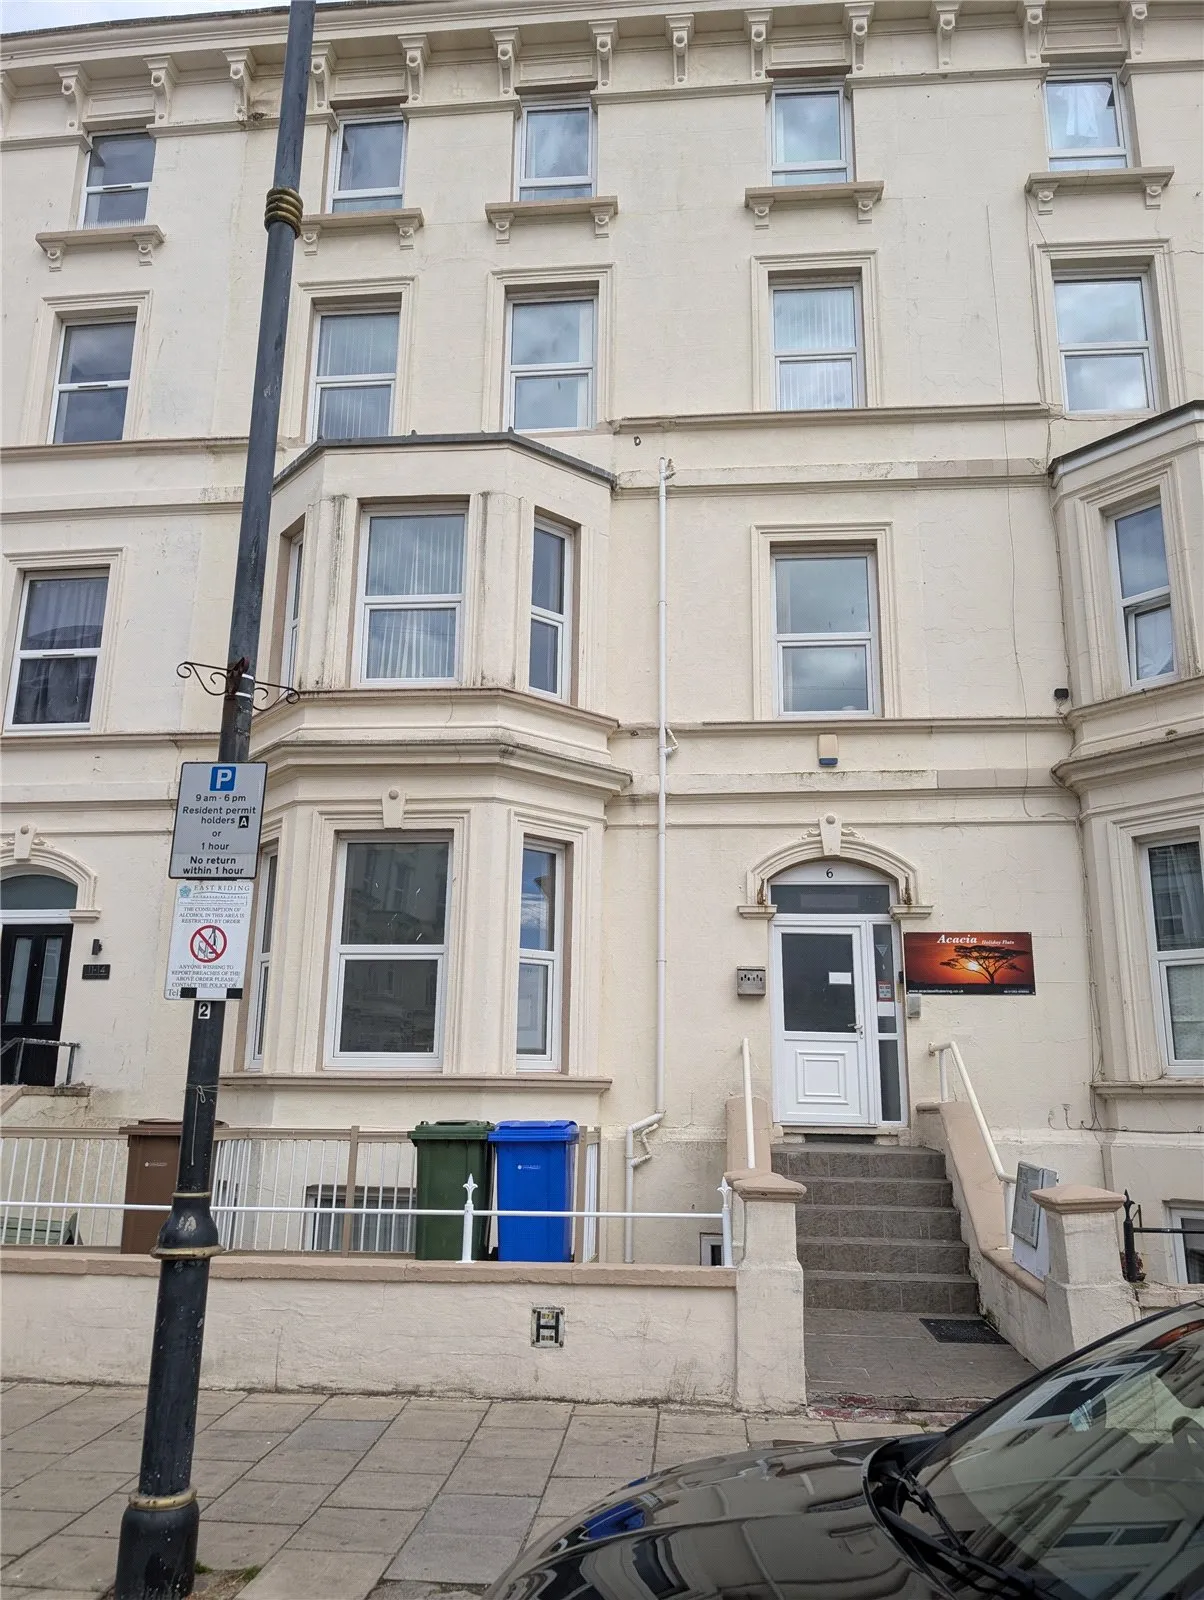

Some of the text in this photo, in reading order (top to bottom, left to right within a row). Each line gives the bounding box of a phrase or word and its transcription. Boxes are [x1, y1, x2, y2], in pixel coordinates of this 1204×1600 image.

[215, 769, 232, 789] P
[182, 806, 256, 815] Resident permit
[200, 816, 248, 827] holders A
[190, 856, 236, 864] No return
[182, 866, 244, 874] within 1 hour
[826, 868, 834, 878] 6
[936, 934, 977, 944] Acacia
[200, 1003, 208, 1017] 2
[536, 1311, 560, 1343] H
